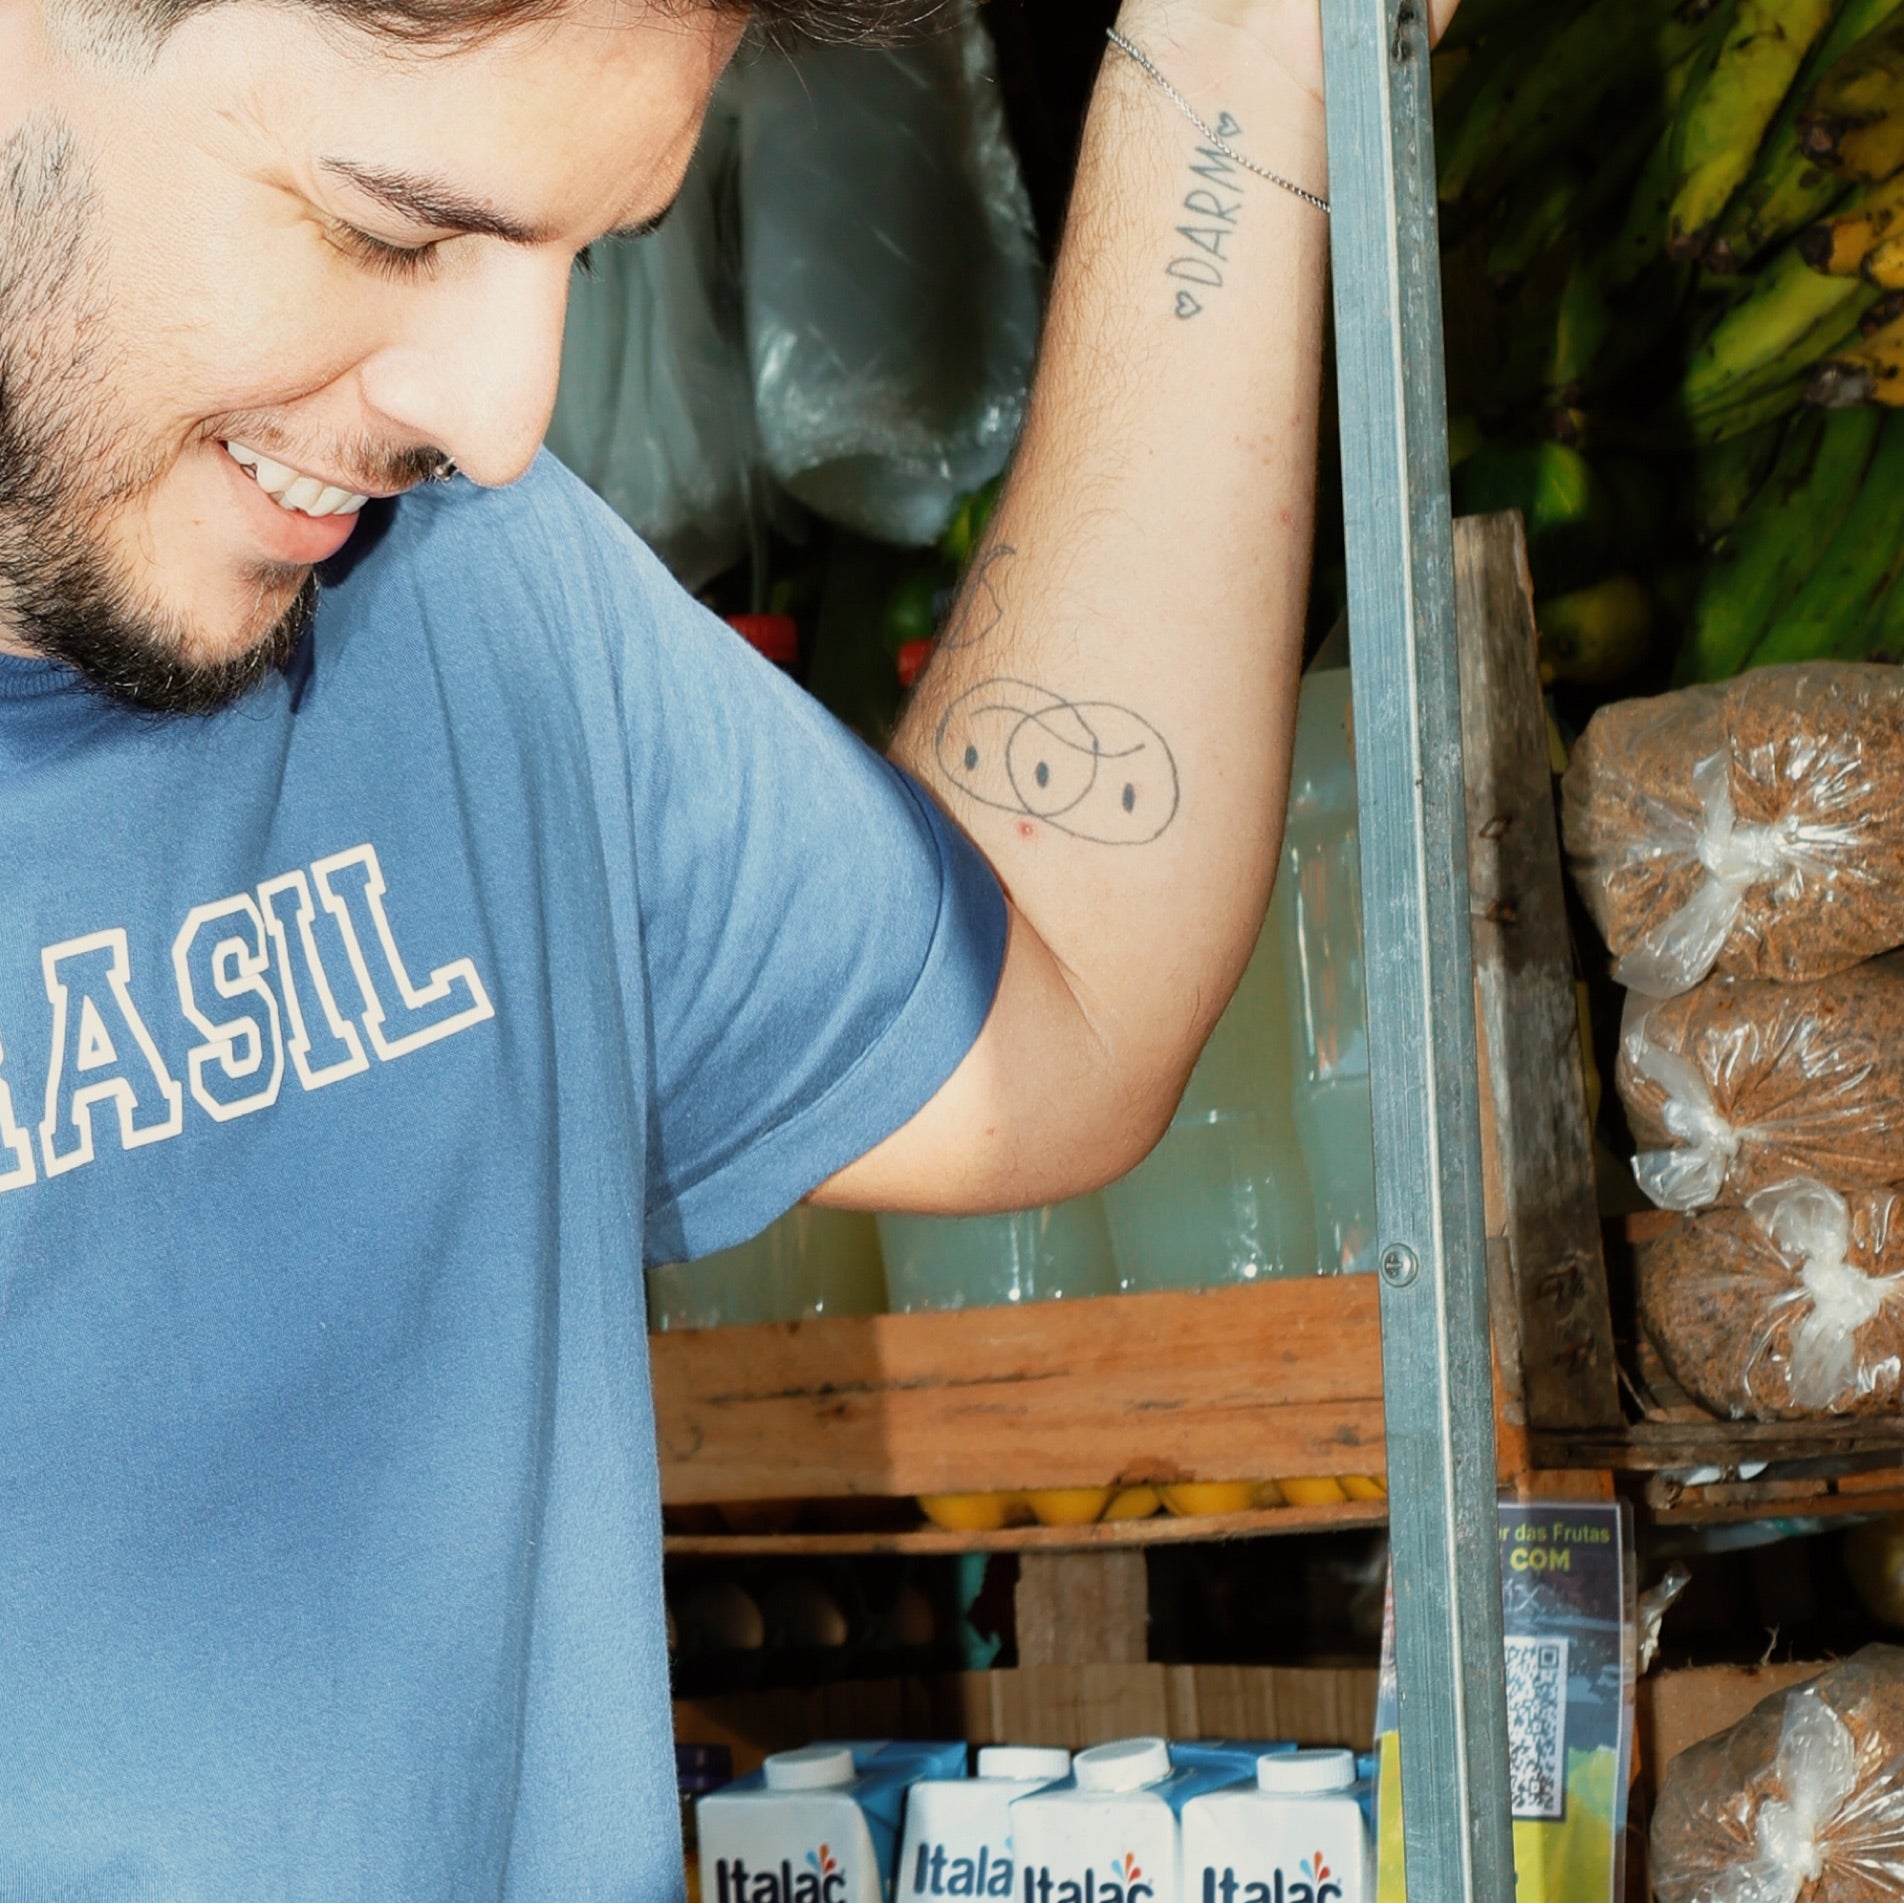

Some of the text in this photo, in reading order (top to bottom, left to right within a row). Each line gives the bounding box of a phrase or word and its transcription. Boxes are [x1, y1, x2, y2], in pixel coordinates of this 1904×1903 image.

[1514, 1522, 1546, 1542] das
[1553, 1521, 1610, 1544] Frutas
[1509, 1547, 1571, 1572] COM
[913, 1842, 1014, 1897] Itala
